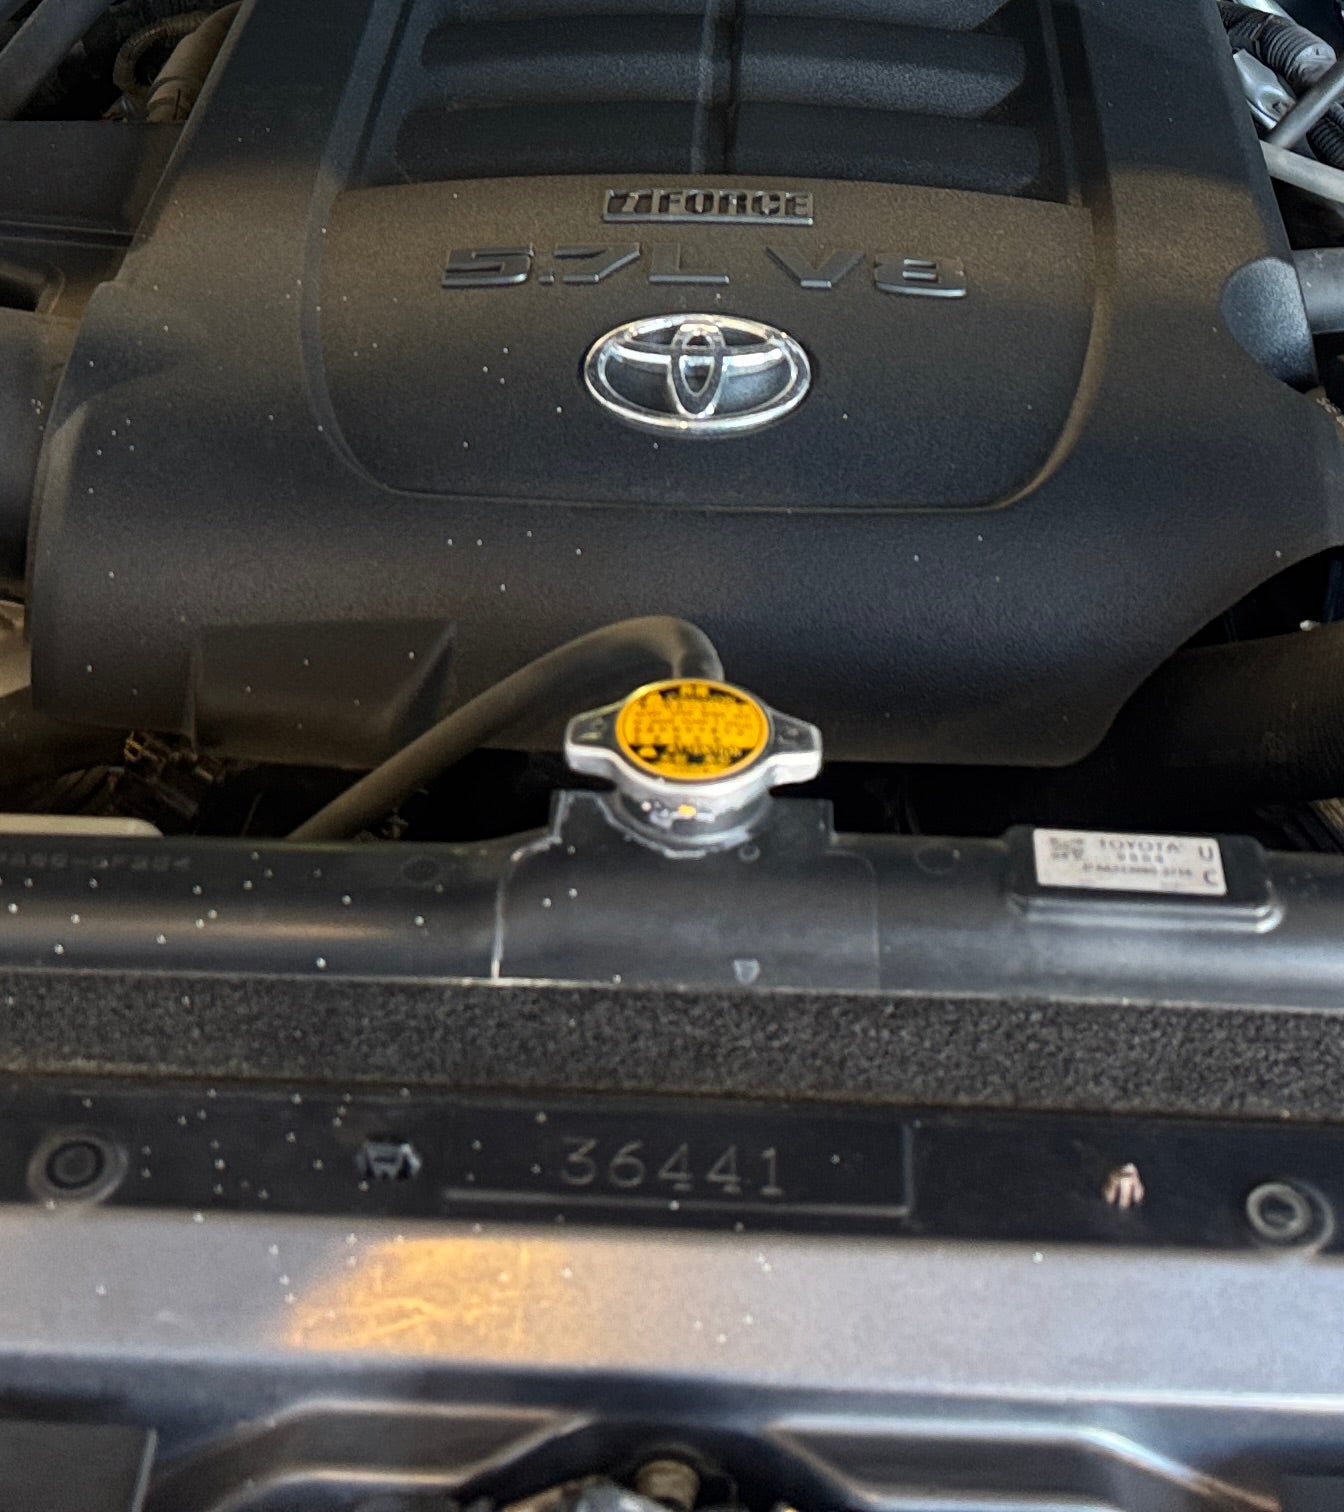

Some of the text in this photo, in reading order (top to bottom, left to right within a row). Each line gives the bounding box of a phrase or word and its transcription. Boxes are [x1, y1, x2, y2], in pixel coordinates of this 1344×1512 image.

[442, 242, 966, 297] 5.7L V8
[1100, 839, 1181, 854] TOYOTA
[561, 1136, 784, 1196] 36441
